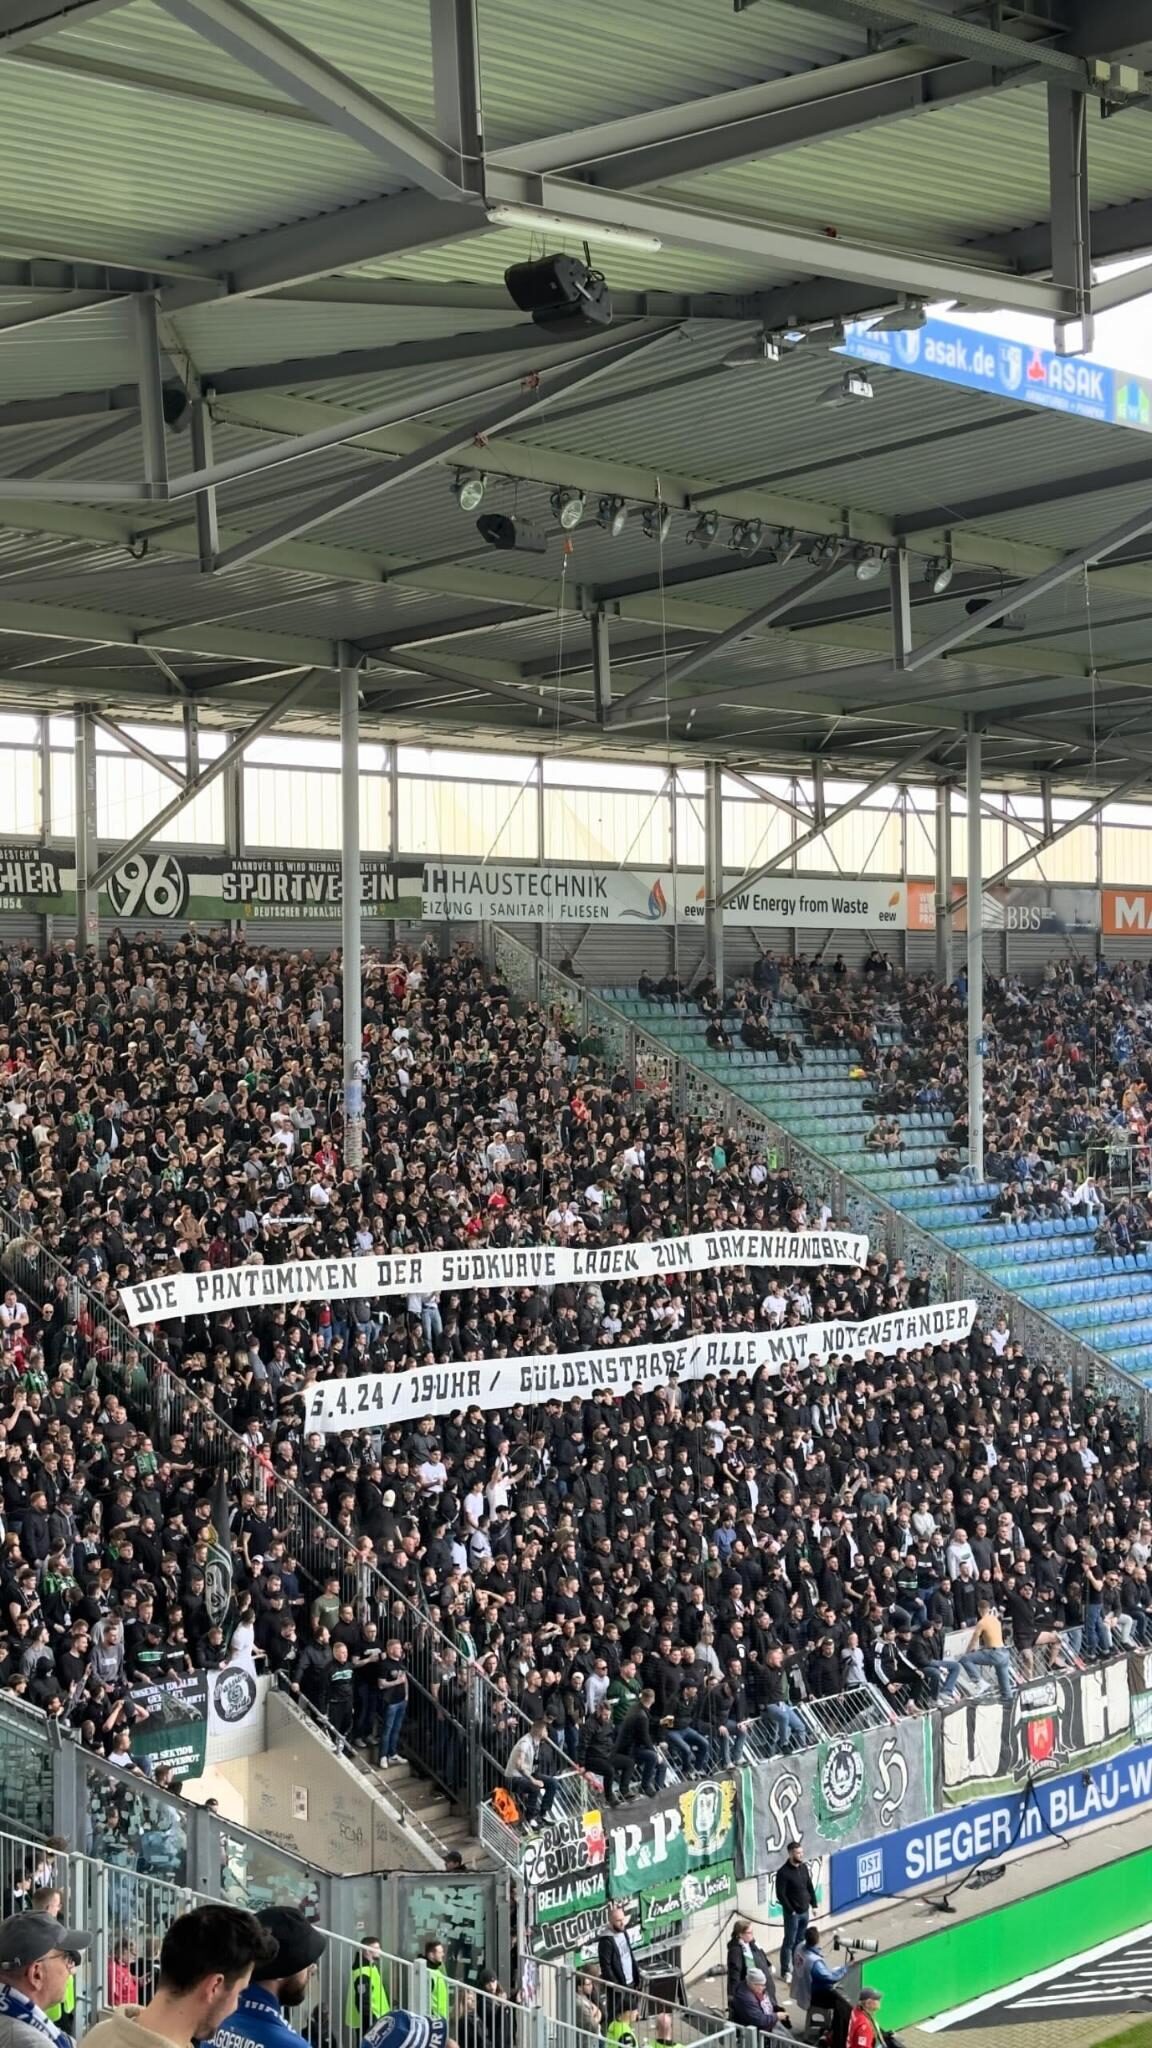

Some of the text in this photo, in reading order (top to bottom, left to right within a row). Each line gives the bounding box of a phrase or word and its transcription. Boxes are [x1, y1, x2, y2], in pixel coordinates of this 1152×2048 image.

[923, 337, 996, 378] asak.de
[1048, 358, 1105, 402] ASAK
[107, 853, 184, 918] 96
[222, 872, 395, 902] SPORTVEEIN
[254, 905, 300, 918] DEUTSCHER
[422, 901, 473, 916] EIZUNG
[560, 904, 609, 918] FLIESEN
[753, 894, 796, 916] Energy
[799, 896, 828, 911] from
[831, 898, 869, 914] Waste
[878, 911, 897, 922] eew
[1007, 906, 1041, 930] BBS
[1114, 896, 1152, 929] M
[136, 1282, 178, 1313] DIE
[196, 1263, 357, 1302] PANTOMIMEN
[377, 1258, 423, 1286] DER
[441, 1251, 556, 1282] SÜDKURVE
[573, 1247, 639, 1275] LADEN
[656, 1242, 693, 1268] ZUM
[706, 1341, 756, 1367] ALLE
[768, 1334, 808, 1362] MIT
[823, 1306, 969, 1353] NOTENSTÄNDER
[610, 1807, 682, 1877] P&P
[905, 1808, 1012, 1879] SIEGER
[1019, 1801, 1042, 1839] in
[861, 1855, 879, 1873] OST
[538, 1883, 573, 1911] BELLA
[859, 1872, 881, 1895] BAU
